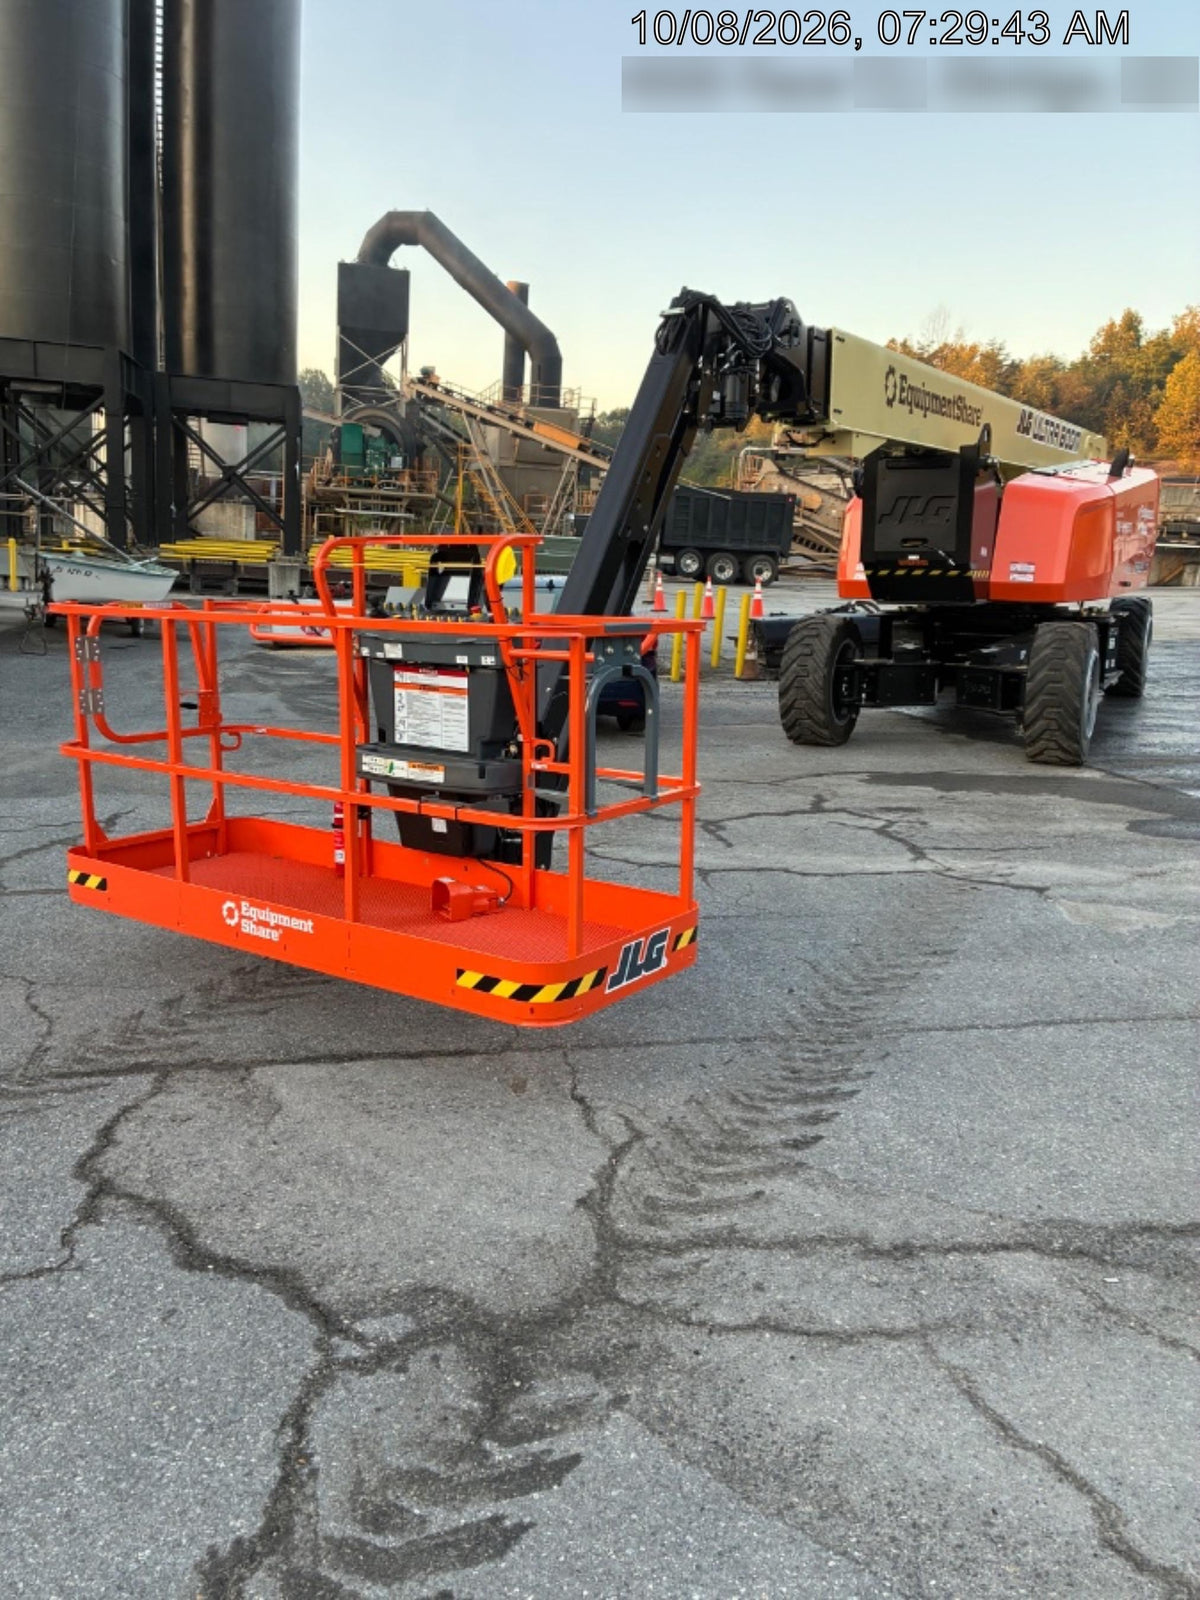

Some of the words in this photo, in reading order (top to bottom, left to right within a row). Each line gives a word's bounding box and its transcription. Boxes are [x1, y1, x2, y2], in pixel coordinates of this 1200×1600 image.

[898, 373, 981, 427] EquipmentShare
[878, 495, 956, 525] JLG
[240, 901, 314, 934] Equipment
[240, 919, 280, 941] Share
[605, 926, 671, 994] JLG
